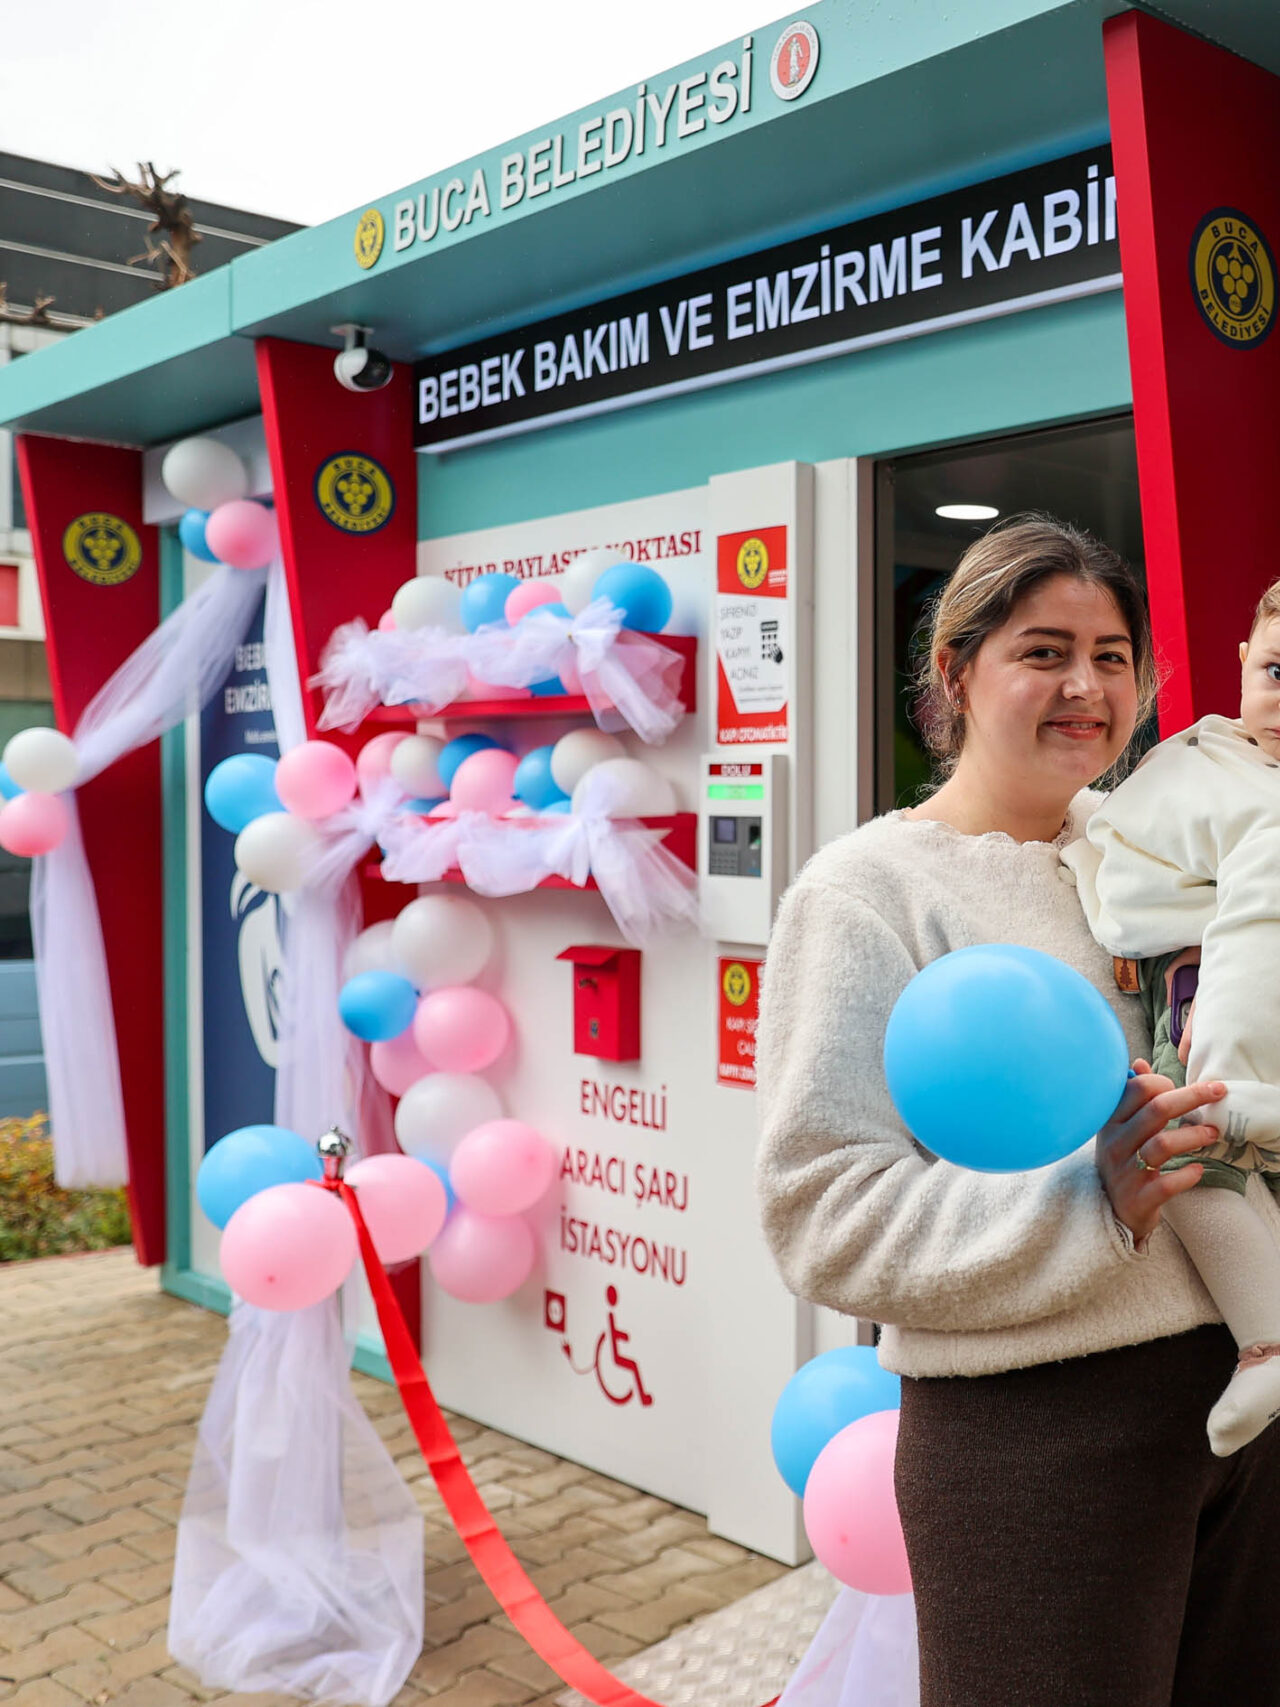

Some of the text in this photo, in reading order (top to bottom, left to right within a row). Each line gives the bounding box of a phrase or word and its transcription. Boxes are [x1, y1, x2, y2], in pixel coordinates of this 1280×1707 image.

[394, 168, 491, 252] BUCA
[500, 36, 753, 210] BELEDİYESİ
[419, 164, 1117, 424] BEBEK BAKIM VE EMZİRME KABİ
[1200, 222, 1270, 339] BUCA BELEDİYESİ
[605, 531, 702, 563] OKTASI
[580, 1079, 668, 1131] ENGELLİ
[560, 1147, 689, 1211] ARACI ŞARJ
[560, 1205, 687, 1286] İSTASYONU
